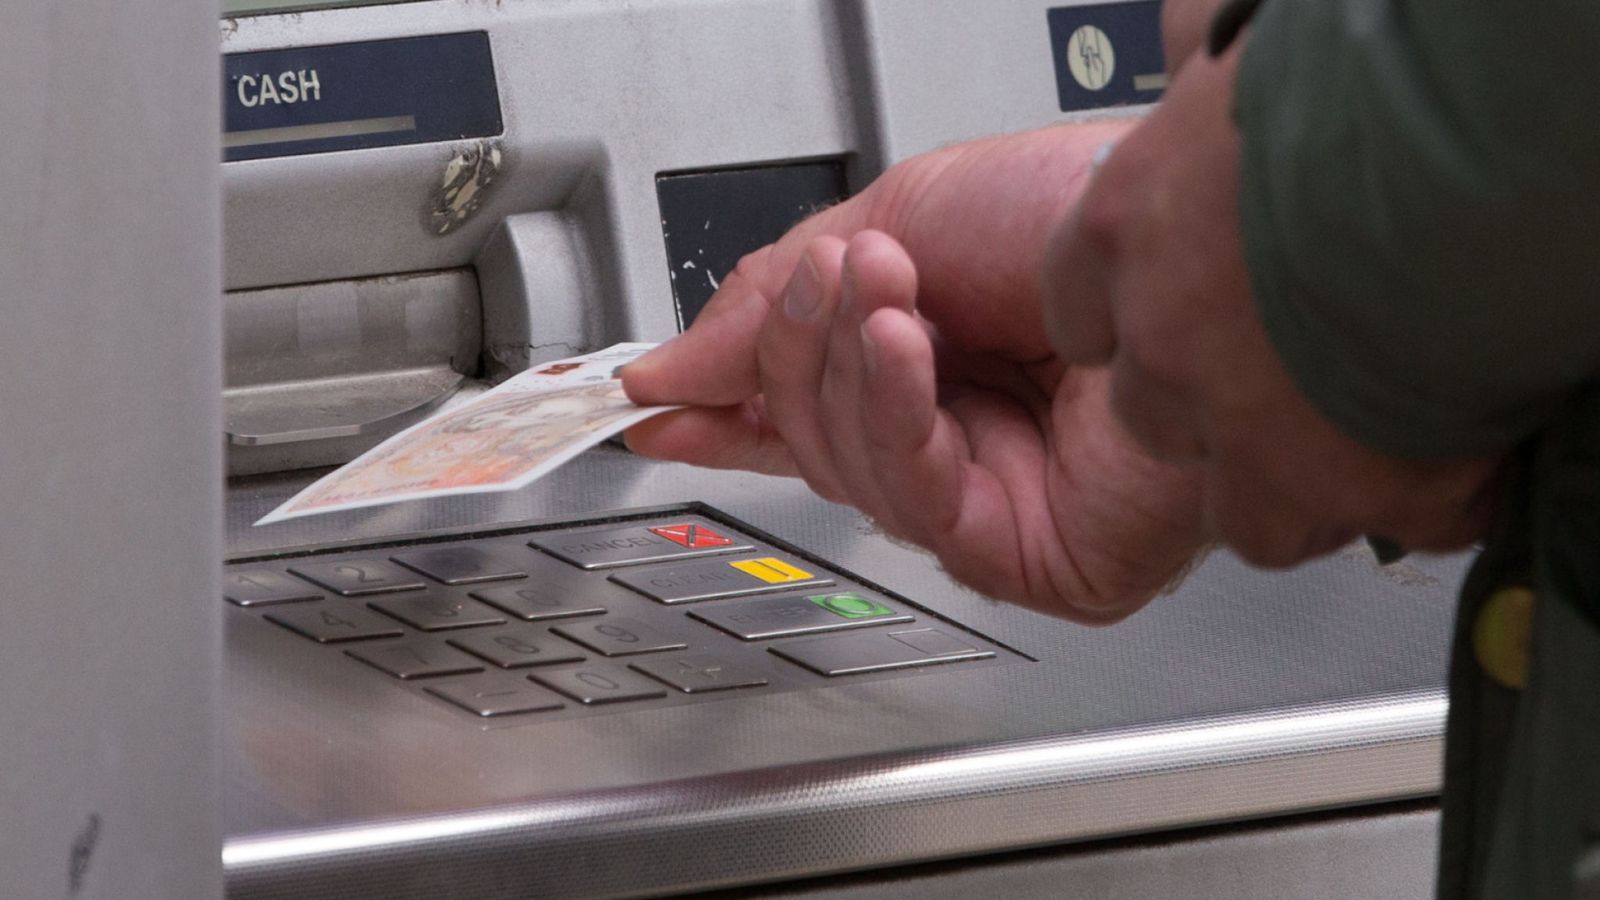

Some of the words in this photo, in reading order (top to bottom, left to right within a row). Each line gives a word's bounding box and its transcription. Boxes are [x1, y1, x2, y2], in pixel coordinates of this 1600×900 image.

[238, 70, 321, 107] CASH
[561, 536, 663, 554] CANCEL
[238, 575, 275, 592] 1
[334, 566, 384, 583] 2
[594, 624, 640, 643] 9
[494, 636, 540, 655] 8
[575, 672, 620, 690] 0
